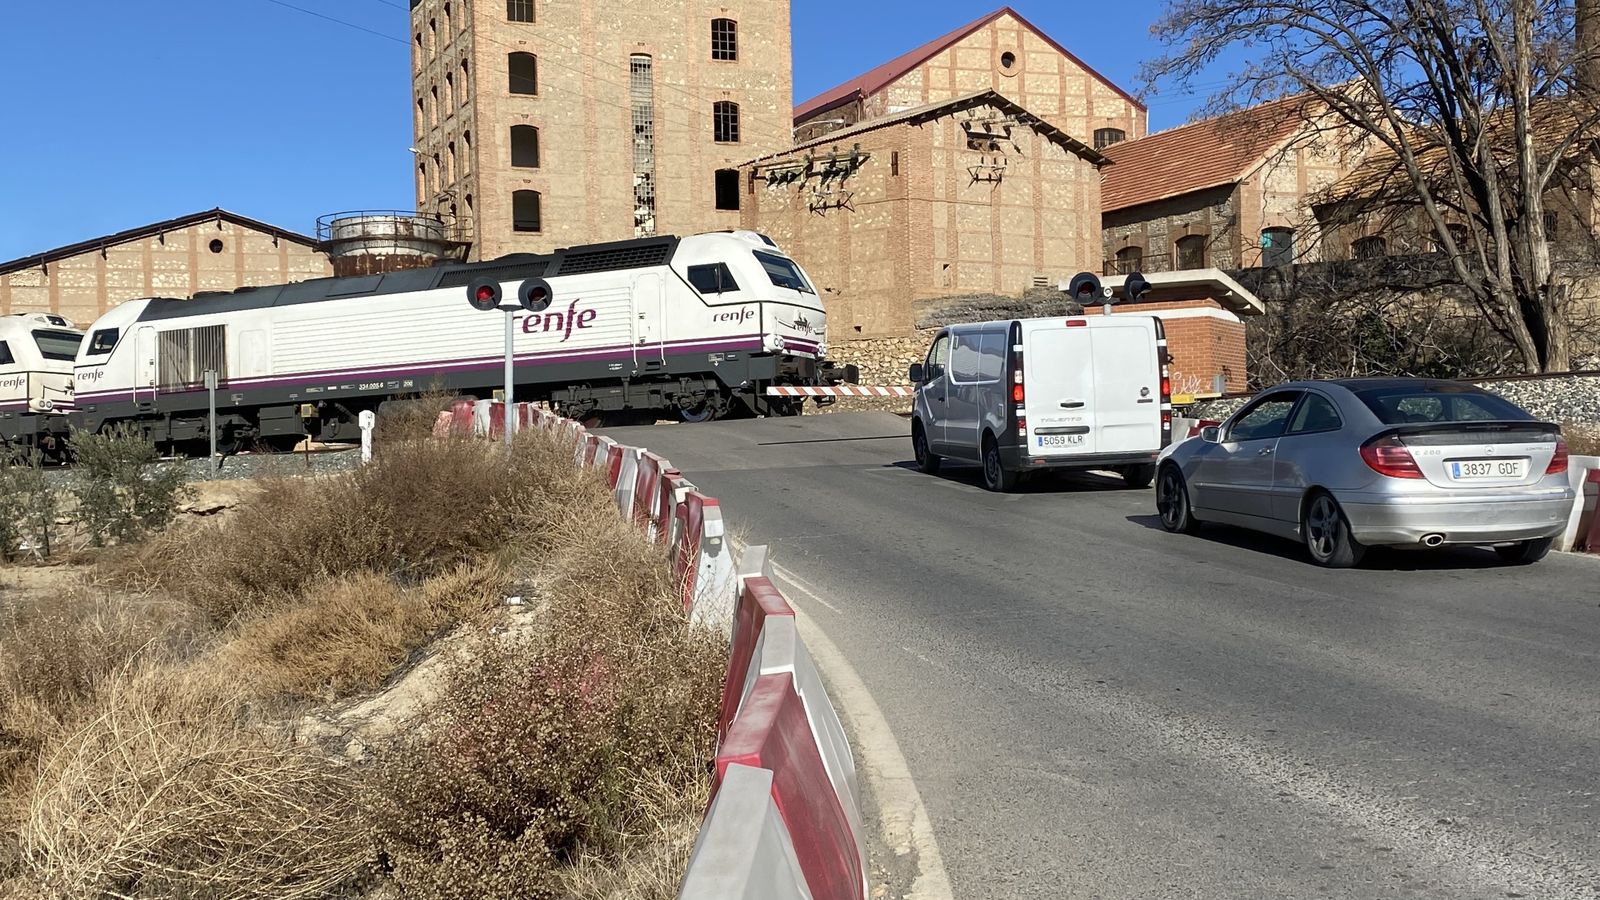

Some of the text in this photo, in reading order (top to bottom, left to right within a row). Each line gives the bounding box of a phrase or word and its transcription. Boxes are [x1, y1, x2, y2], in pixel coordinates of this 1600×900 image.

[713, 306, 755, 325] renfe
[77, 368, 104, 382] renfe
[1043, 436, 1066, 446] 5059
[1067, 435, 1083, 444] KLR
[1463, 461, 1519, 476] 3837 GDF
